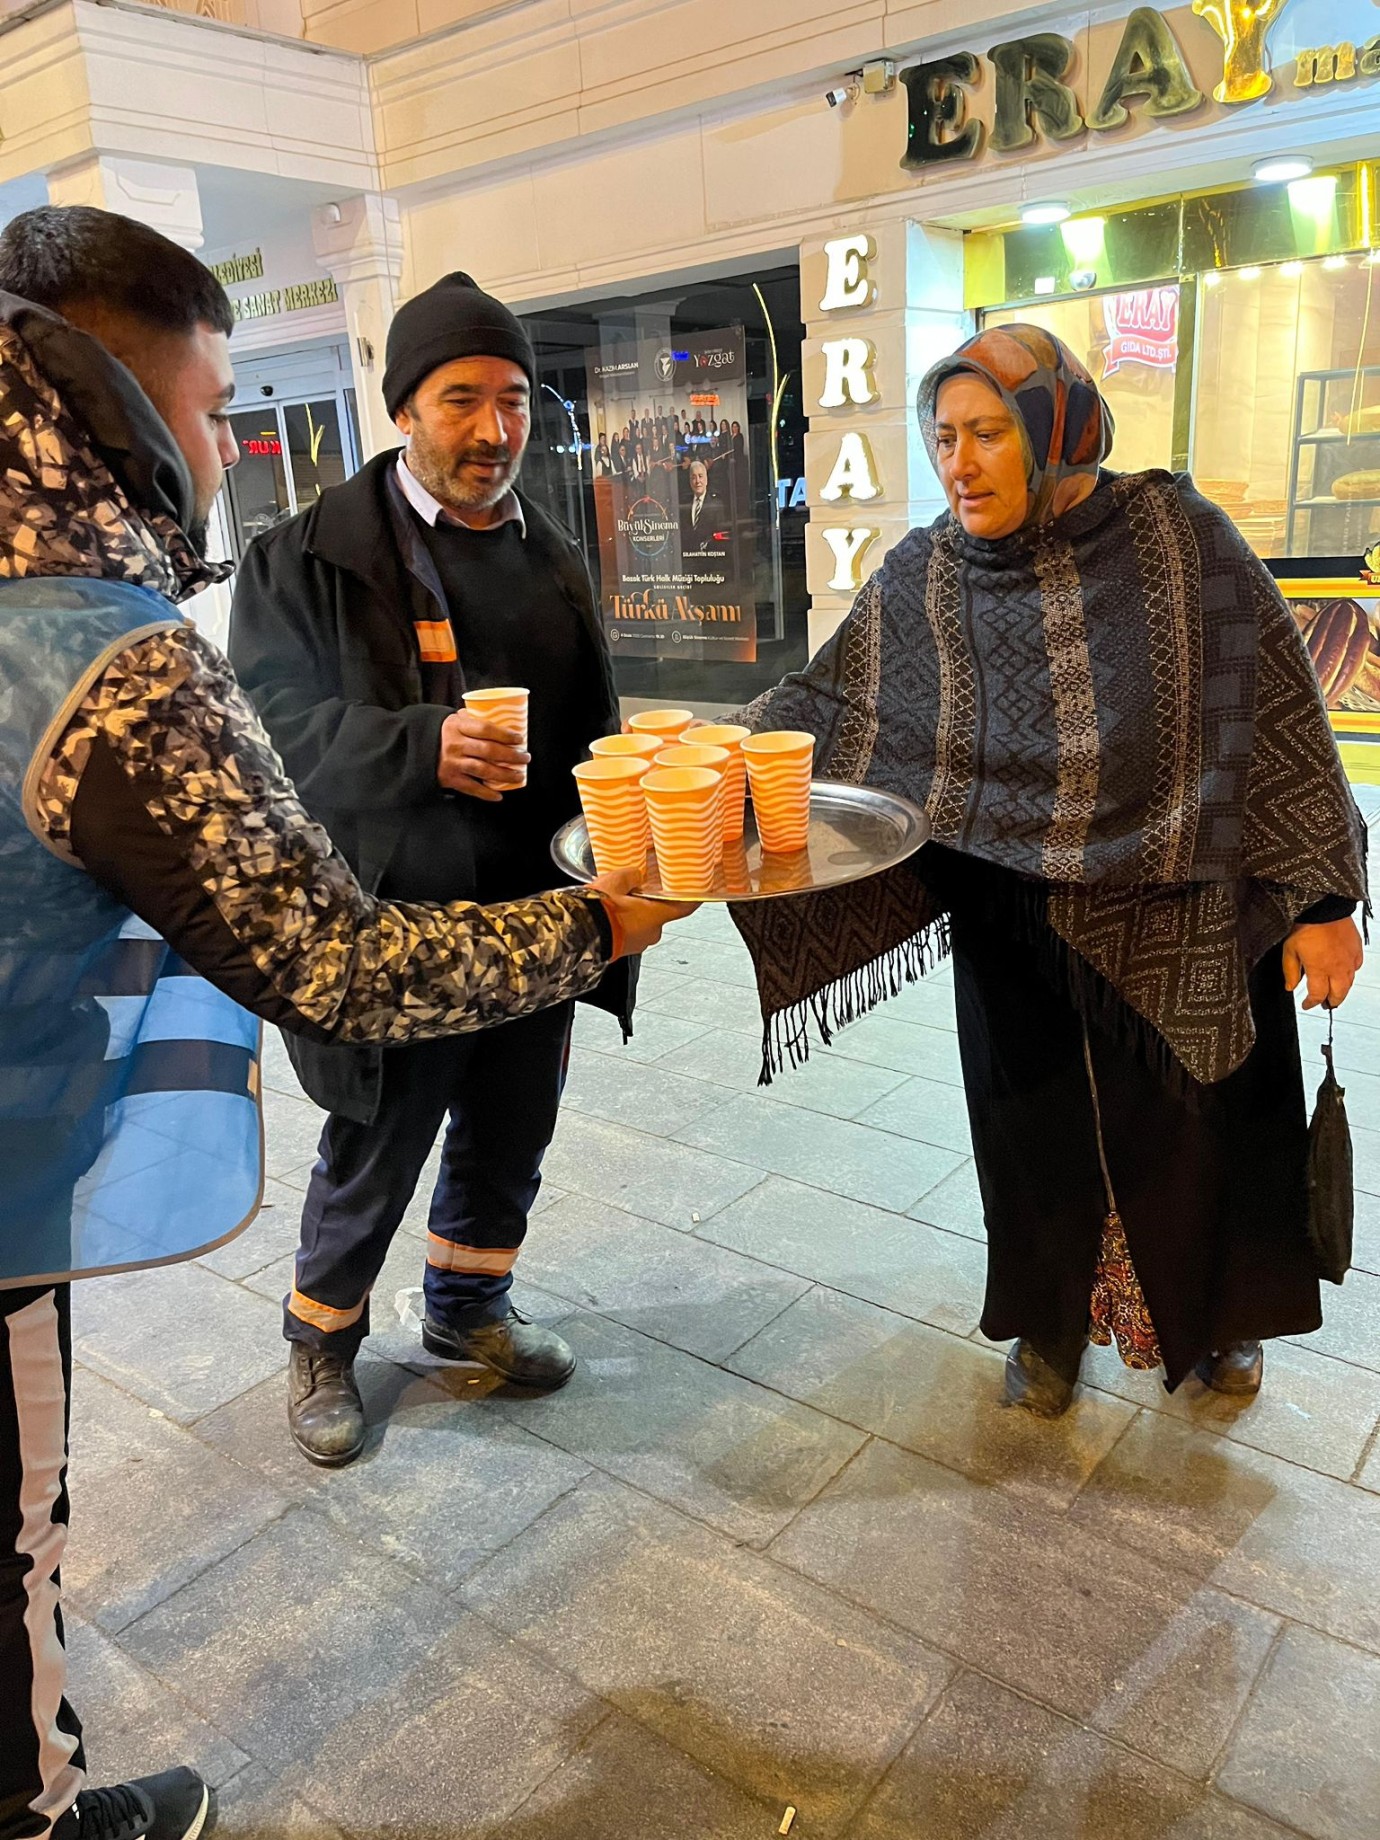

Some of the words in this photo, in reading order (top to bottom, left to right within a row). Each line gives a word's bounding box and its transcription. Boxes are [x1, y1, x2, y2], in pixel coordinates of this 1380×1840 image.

[899, 0, 1285, 170] ERAY
[242, 288, 281, 319] SANAT
[818, 234, 881, 592] ERAY
[656, 573, 671, 582] Halk
